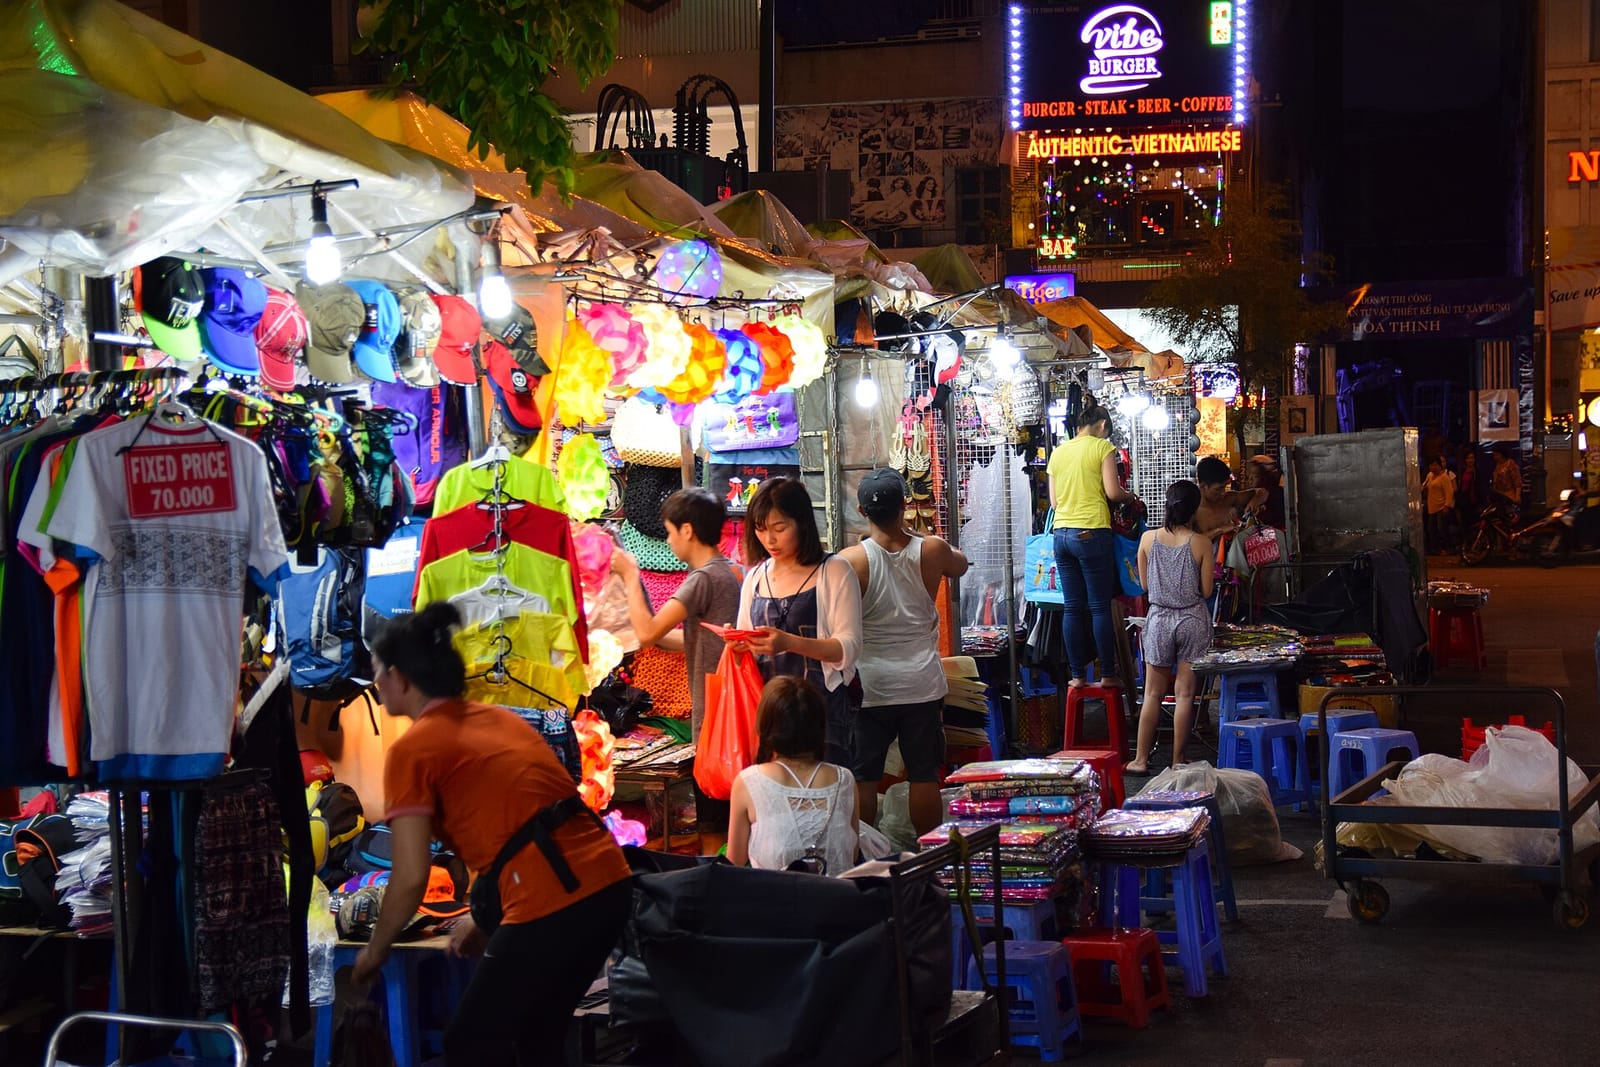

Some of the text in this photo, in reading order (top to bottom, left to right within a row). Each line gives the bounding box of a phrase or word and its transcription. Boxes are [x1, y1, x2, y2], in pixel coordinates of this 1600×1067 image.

[1094, 17, 1161, 49] vibe
[1089, 57, 1158, 76] BURGER
[1023, 96, 1233, 117] BURGER STEAK BEER COFFEE
[1027, 131, 1241, 158] AUTHENTIC VIETNAMESE
[1043, 239, 1075, 256] BAR
[1018, 281, 1064, 304] Tiger
[1550, 289, 1580, 304] Save
[130, 451, 228, 484] FIXED PRICE
[150, 485, 215, 510] 70.000
